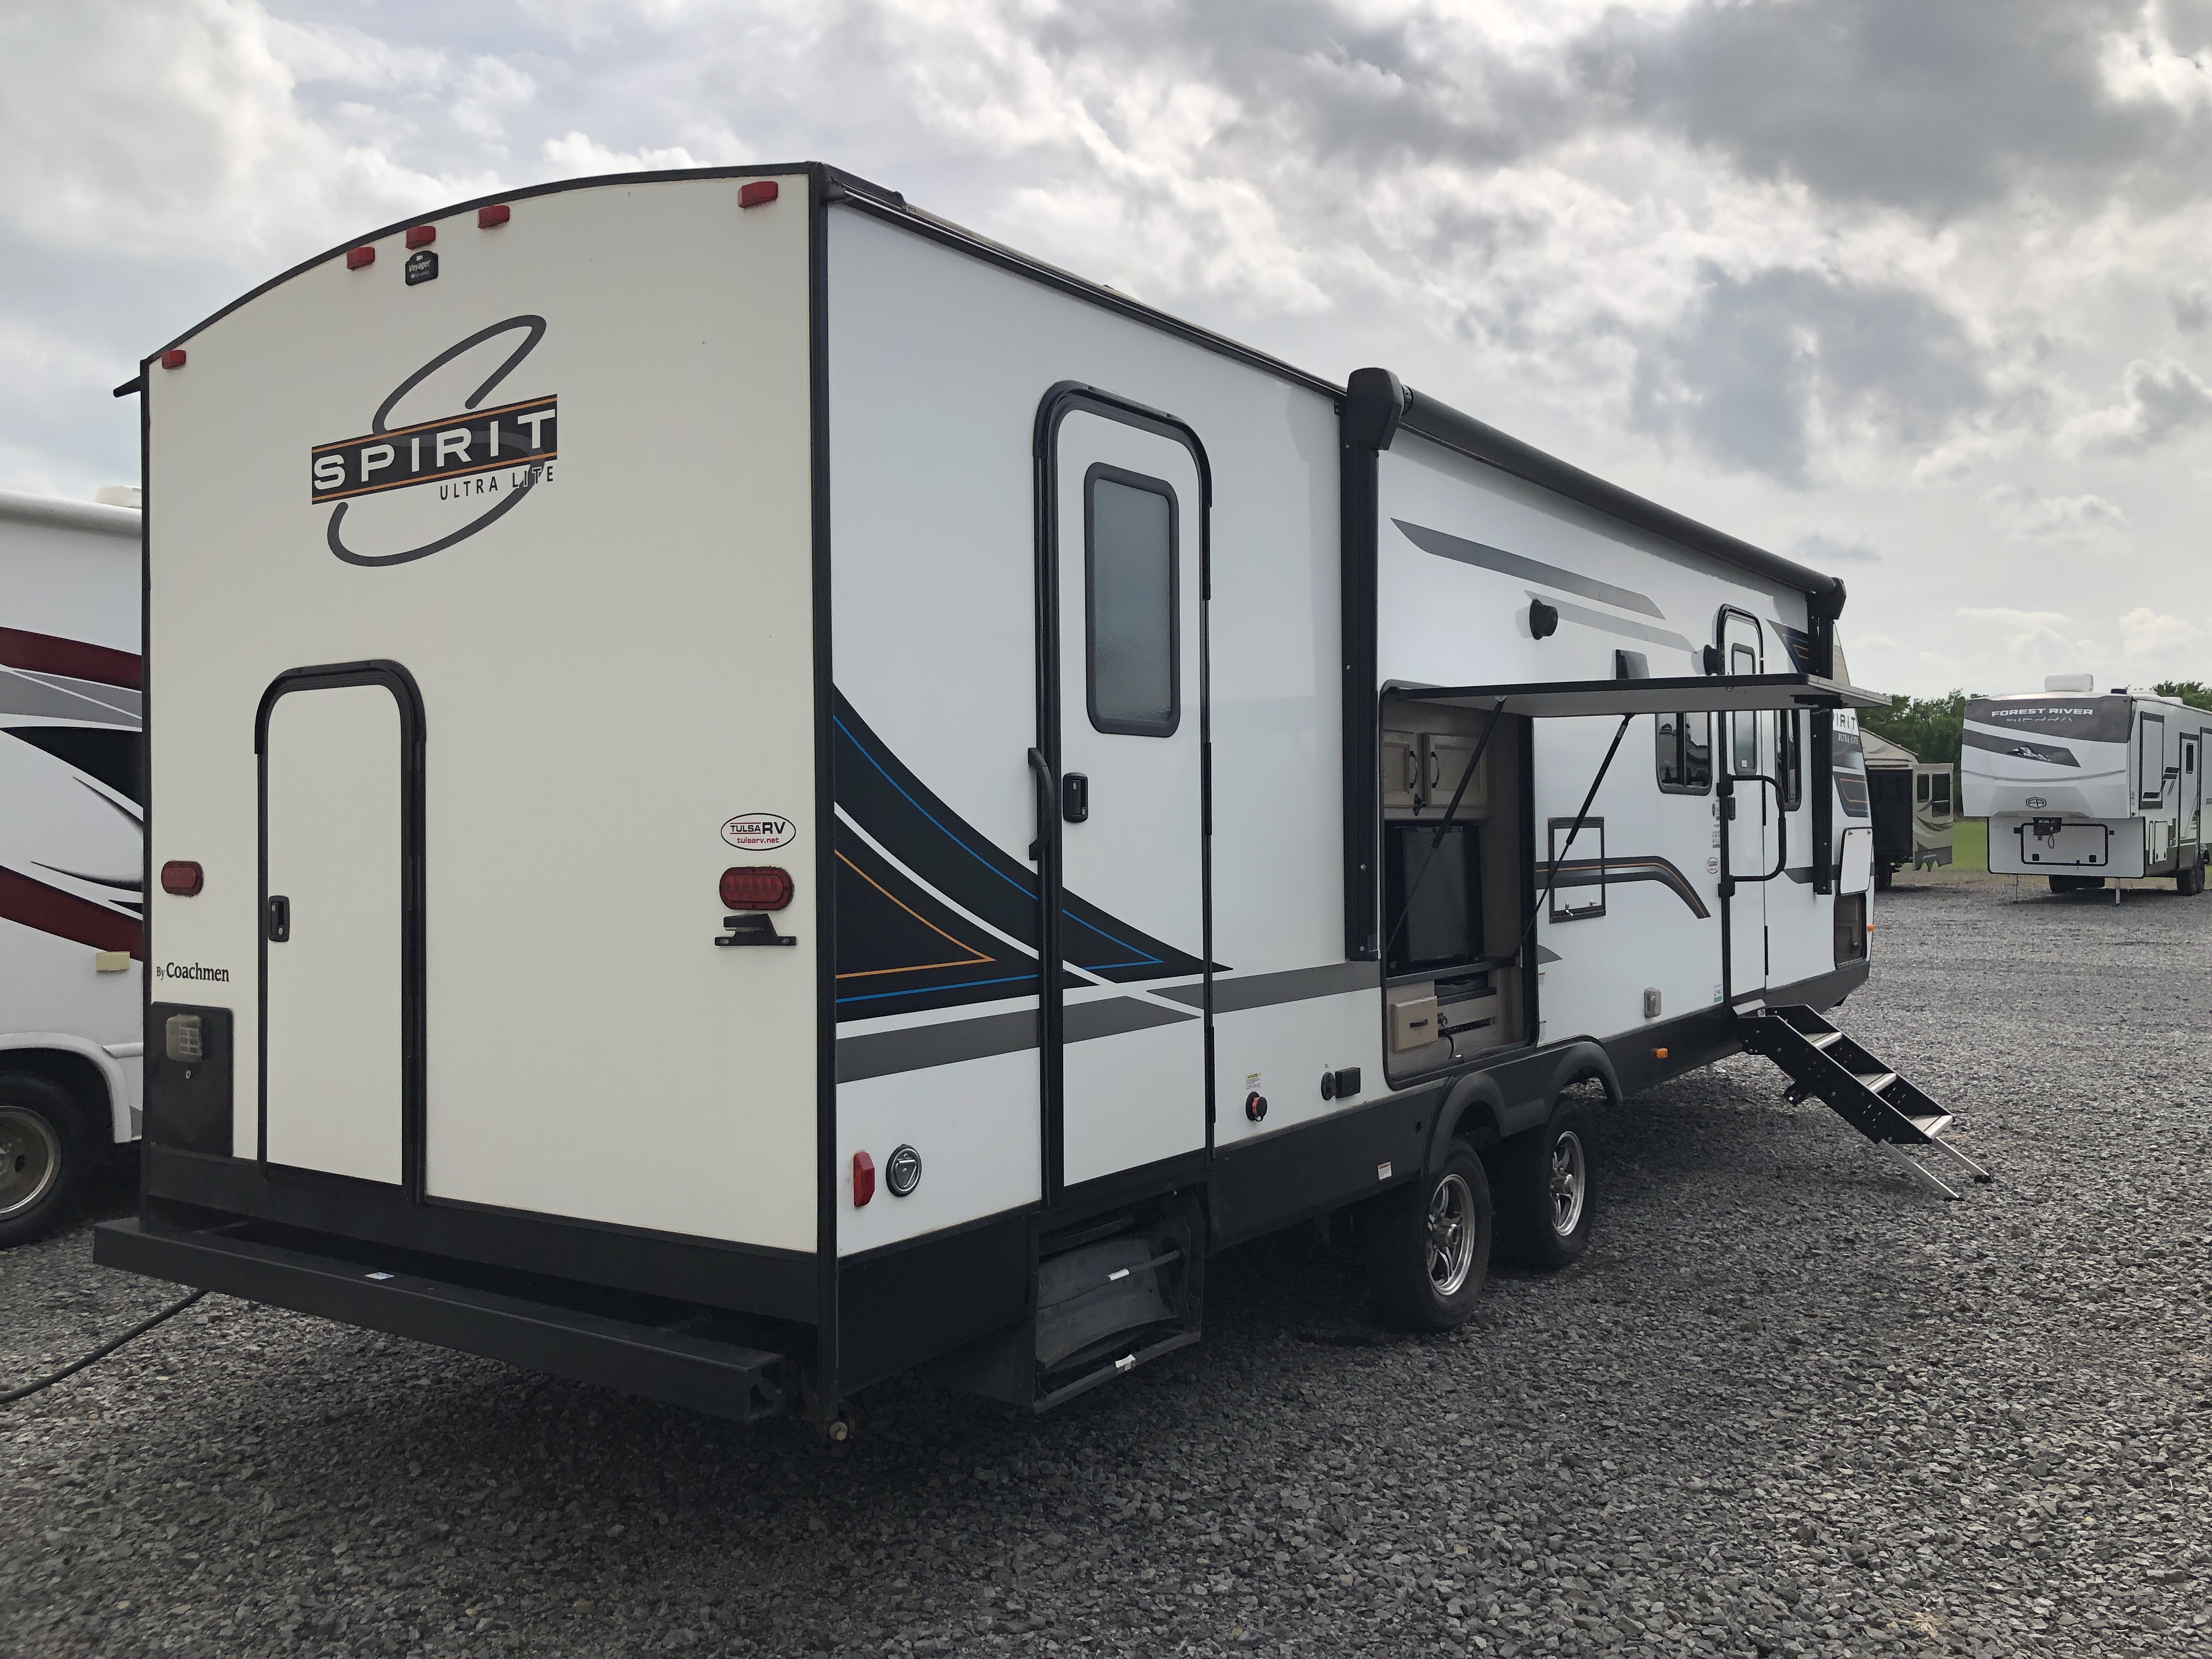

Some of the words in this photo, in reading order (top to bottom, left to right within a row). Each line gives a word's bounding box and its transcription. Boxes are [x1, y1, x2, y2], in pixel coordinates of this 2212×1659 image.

[409, 260, 431, 273] Voyager
[314, 409, 555, 490] SPIRIT
[440, 476, 498, 500] ULTRA
[512, 466, 554, 488] LITE
[1832, 713, 1856, 730] IRIT
[1991, 708, 2046, 717] FOREST
[156, 966, 165, 980] By
[166, 962, 229, 981] Coachmen
